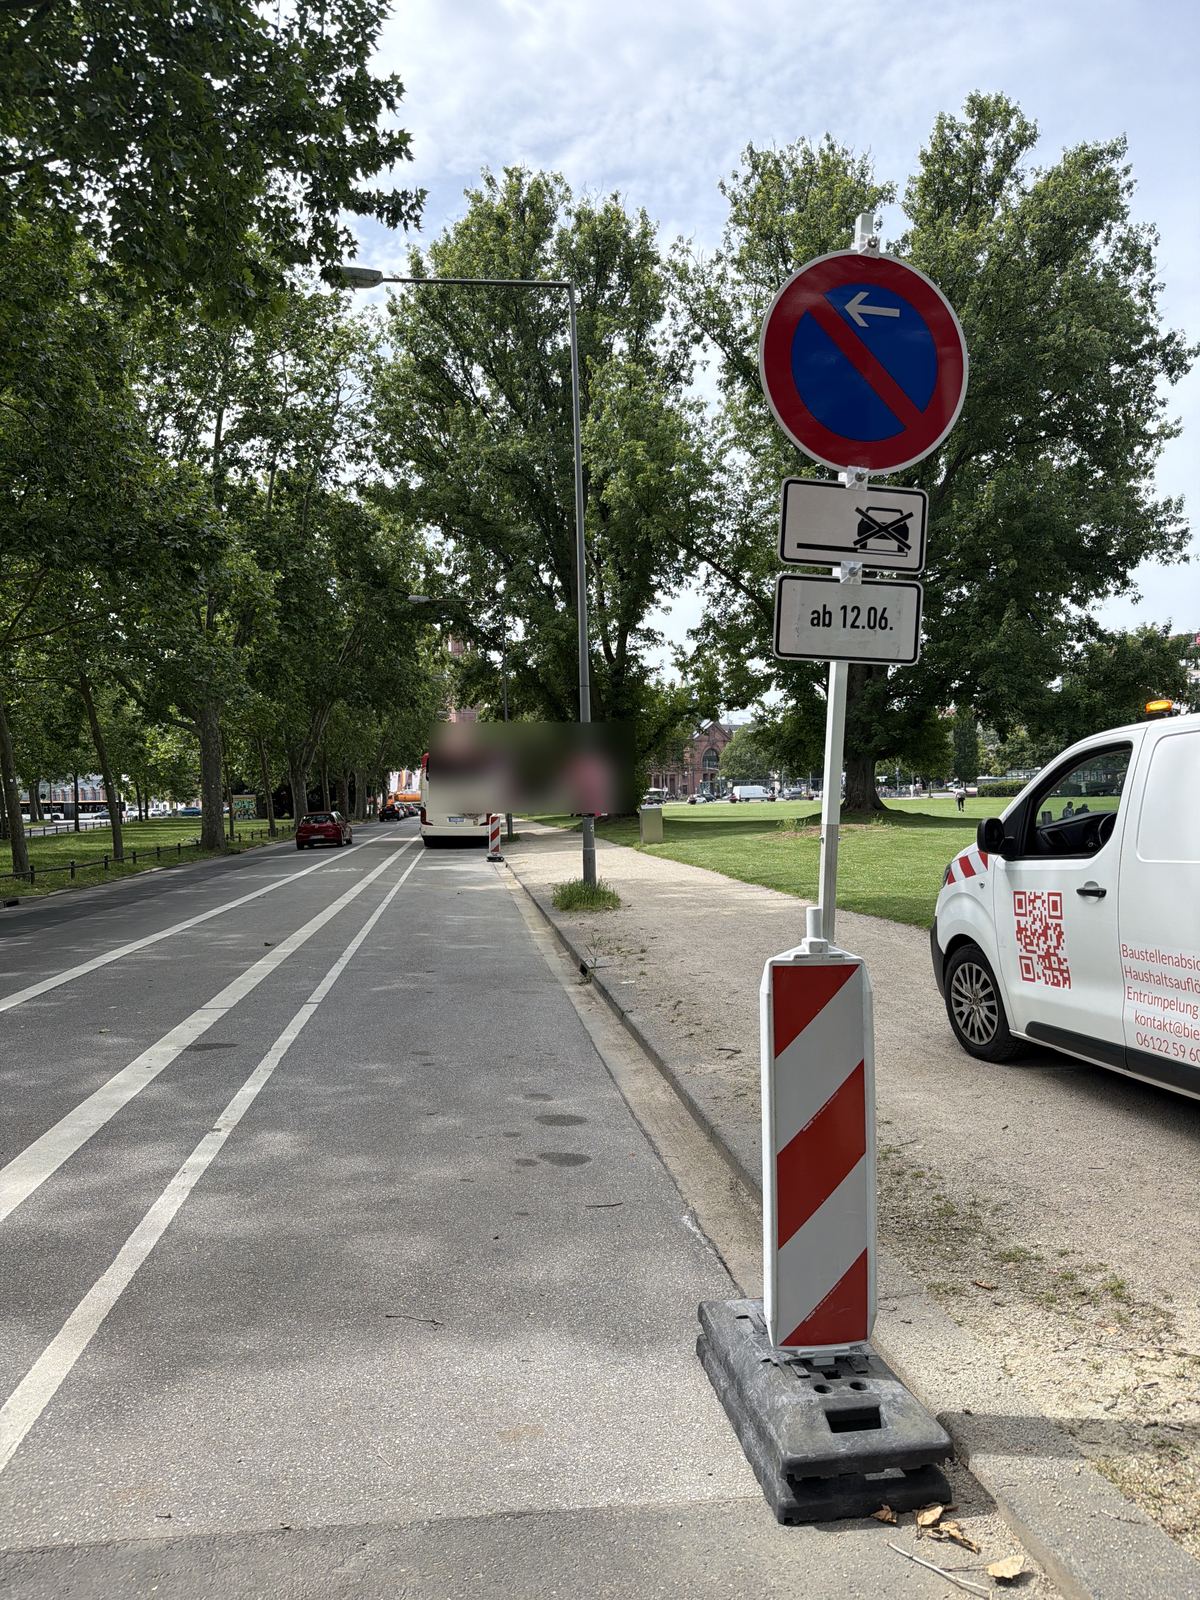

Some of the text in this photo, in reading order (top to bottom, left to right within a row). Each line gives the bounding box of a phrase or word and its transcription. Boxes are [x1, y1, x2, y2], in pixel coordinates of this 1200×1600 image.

[810, 604, 894, 630] ab 12.06.
[1124, 965, 1200, 993] Haushaltsauflö
[1127, 986, 1199, 1020] Entrümpelung
[1135, 1010, 1200, 1040] kontakt@bie
[1136, 1032, 1170, 1055] 06122
[1172, 1042, 1186, 1058] 59
